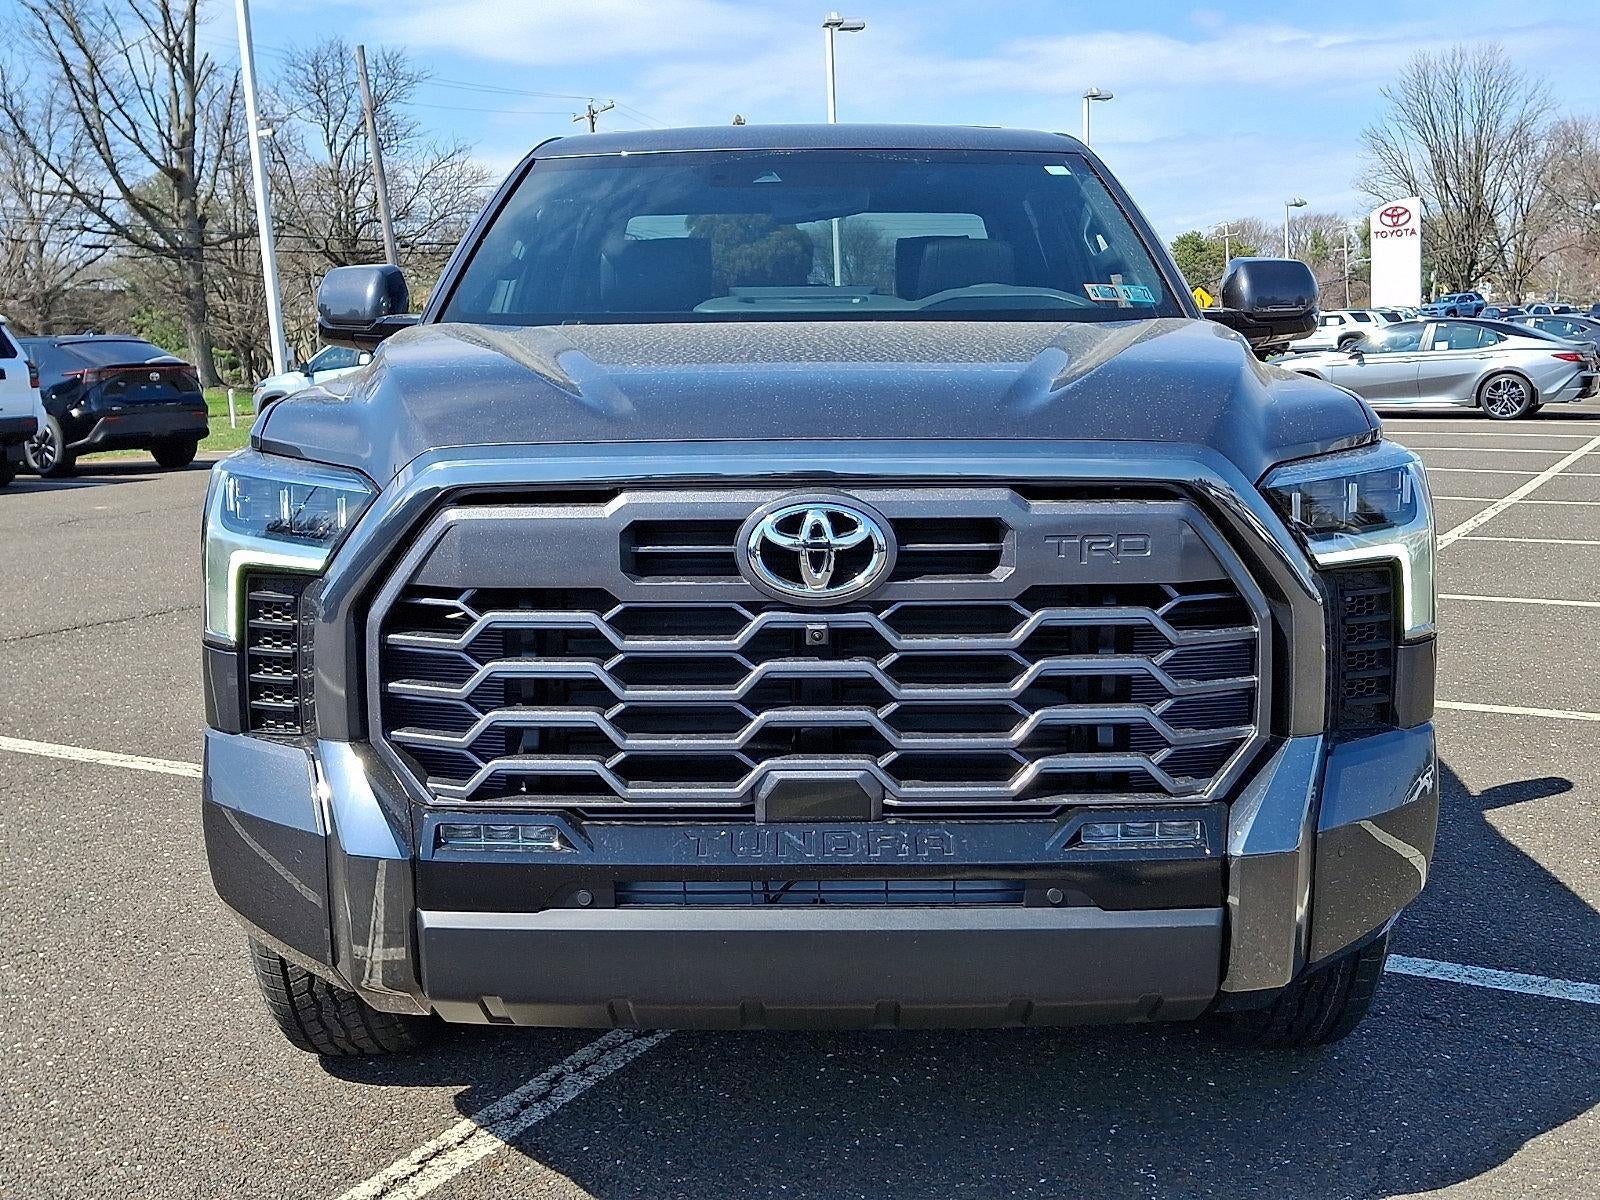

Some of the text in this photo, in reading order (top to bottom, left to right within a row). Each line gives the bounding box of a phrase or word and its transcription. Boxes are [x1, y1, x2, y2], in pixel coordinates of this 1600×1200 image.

[1374, 228, 1417, 239] TOYOTA
[1043, 533, 1151, 565] TRD
[684, 829, 955, 857] TUNDRA
